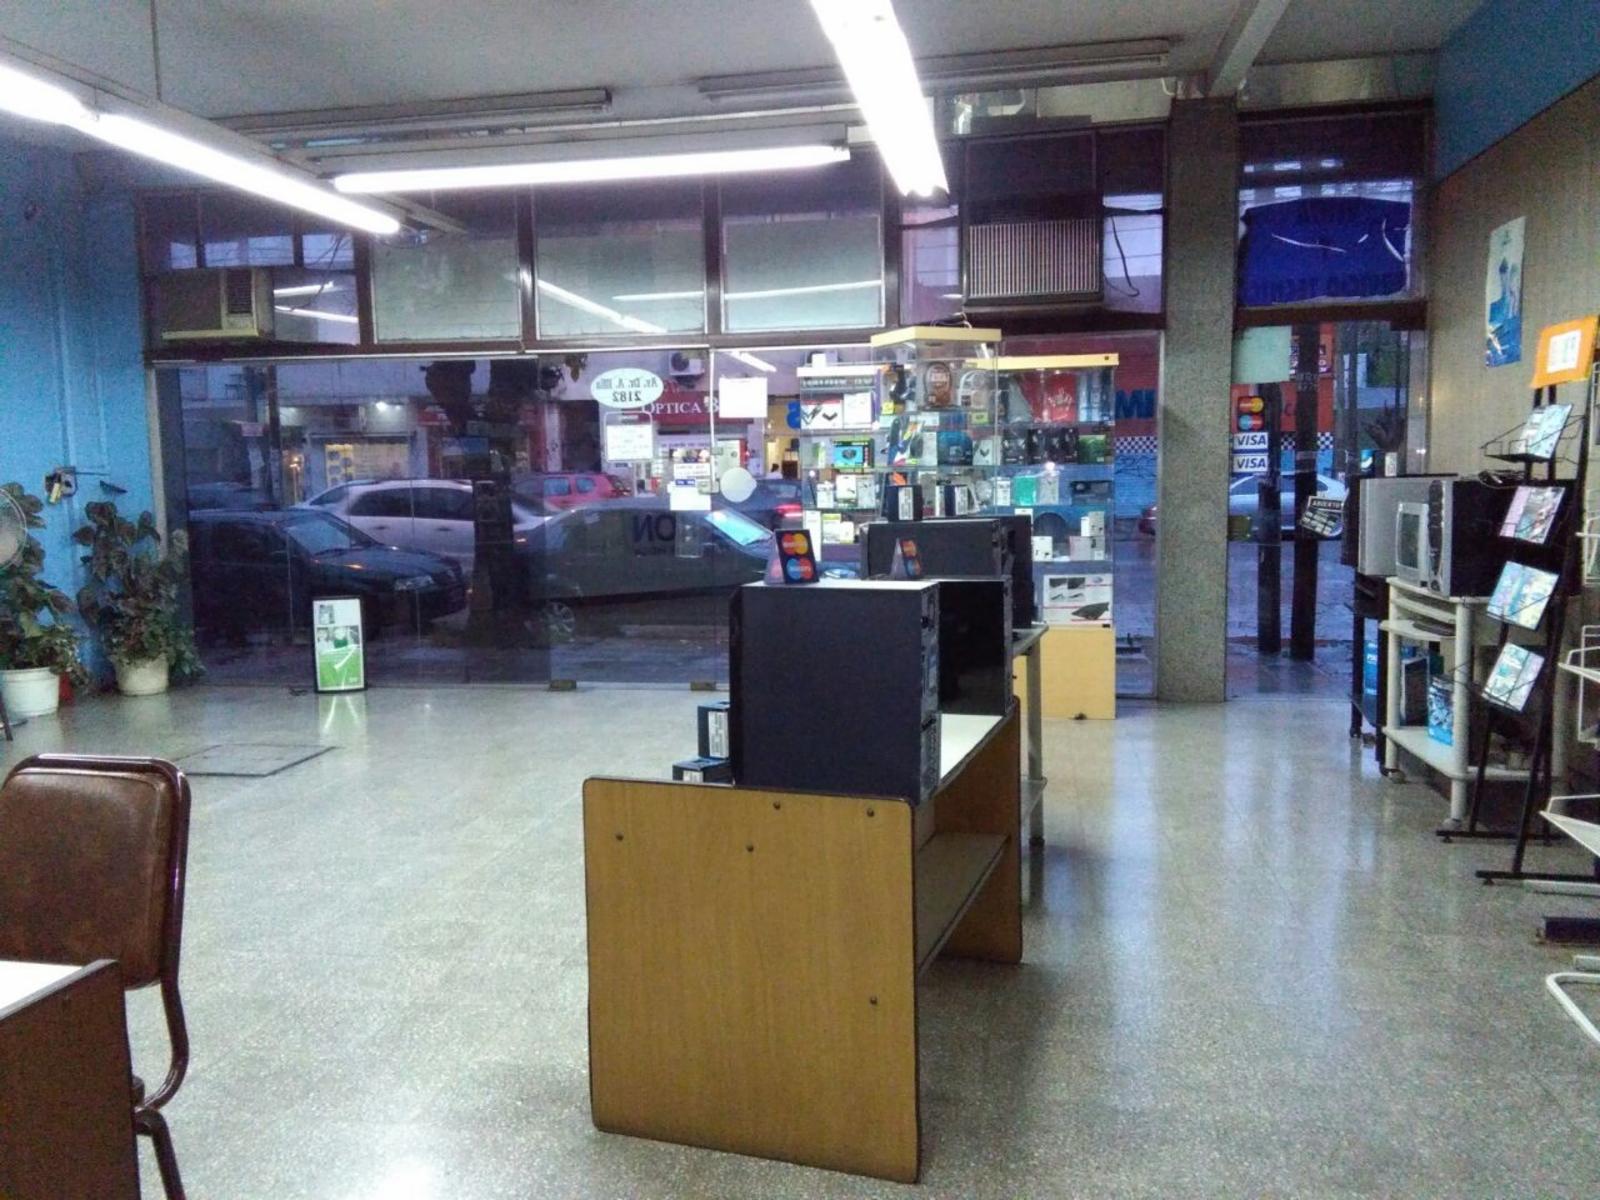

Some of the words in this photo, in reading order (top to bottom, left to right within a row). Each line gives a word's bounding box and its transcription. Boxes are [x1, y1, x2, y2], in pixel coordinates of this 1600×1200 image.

[641, 402, 702, 414] OPTICA
[1237, 434, 1267, 446] VISA
[1236, 458, 1266, 469] VISA
